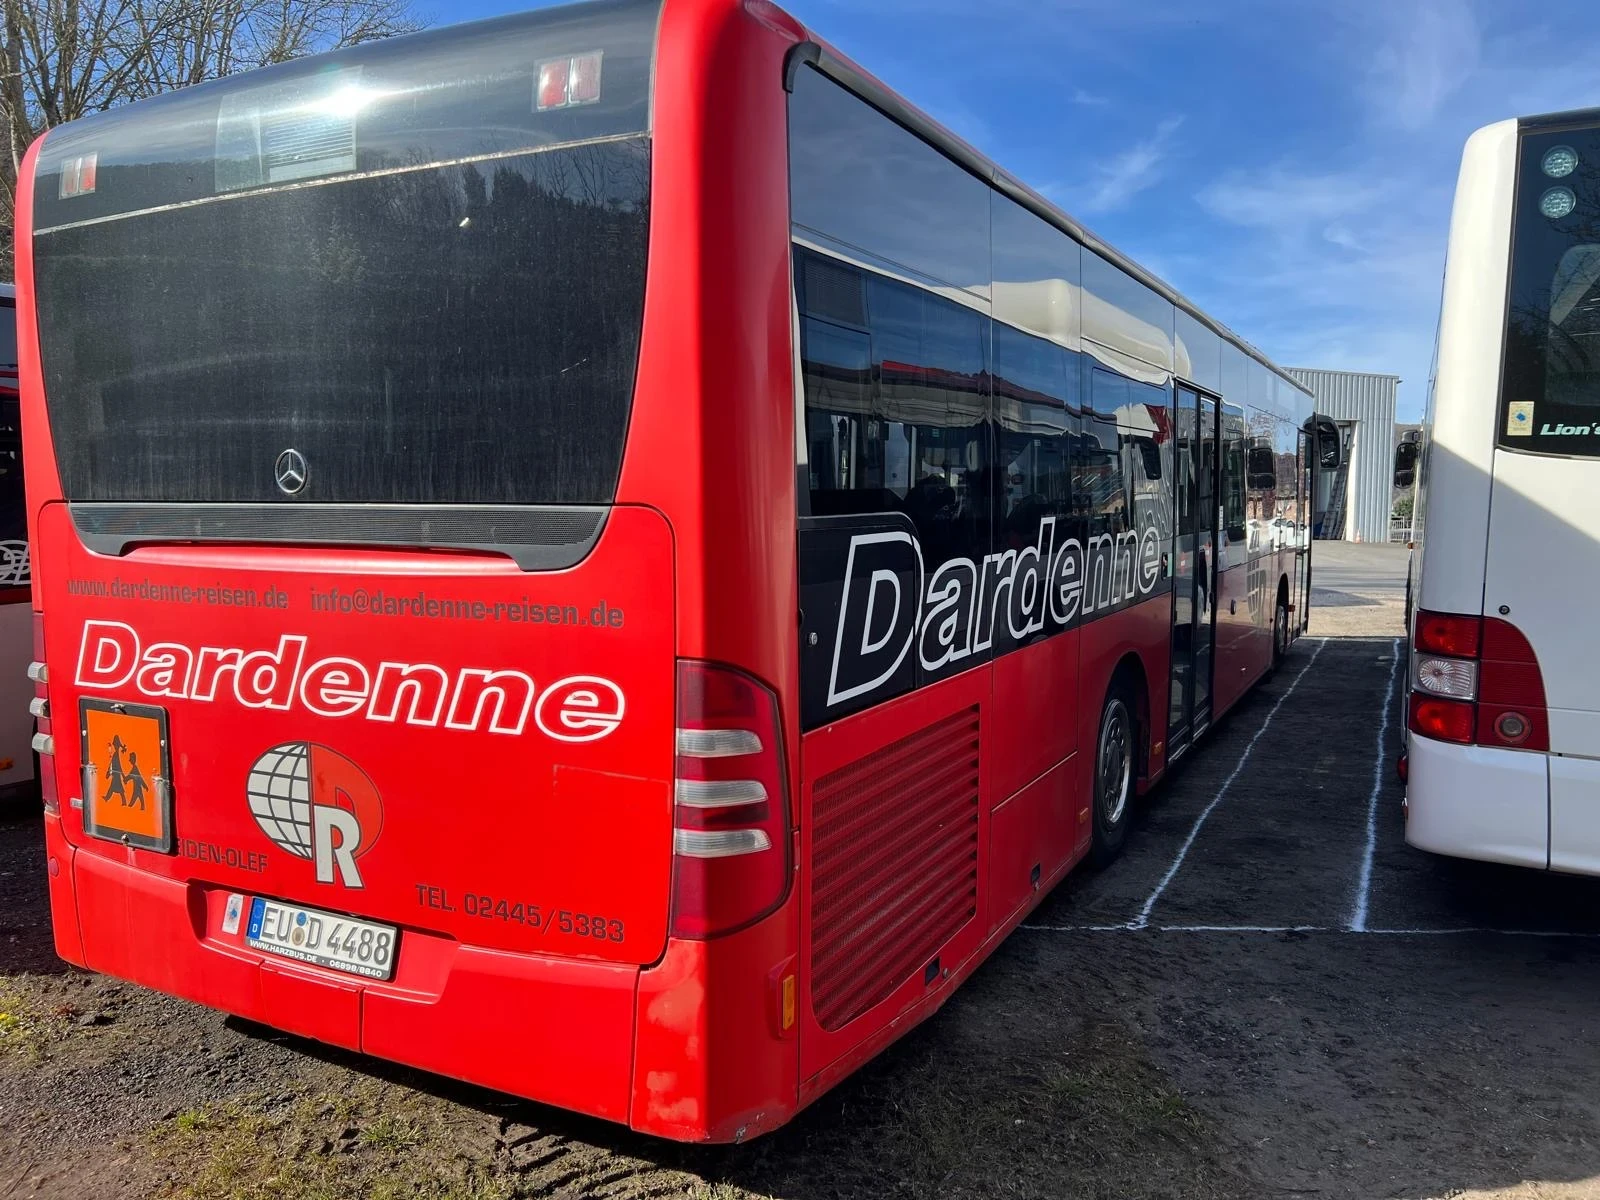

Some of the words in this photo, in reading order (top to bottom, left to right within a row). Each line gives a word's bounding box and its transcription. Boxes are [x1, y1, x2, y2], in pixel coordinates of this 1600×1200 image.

[67, 577, 289, 609] www.dardenne-reisen.de
[310, 587, 625, 628] info@dardenne-reisen.de
[826, 516, 1161, 707] Dardenne
[74, 618, 626, 743] Dardenne
[177, 838, 268, 873] IDEN-OLEF
[262, 906, 295, 943] EU
[305, 917, 323, 950] D
[326, 923, 391, 965] 4488
[463, 893, 625, 943] 02445/5383
[250, 939, 318, 963] WWW.HARZBUS.DE
